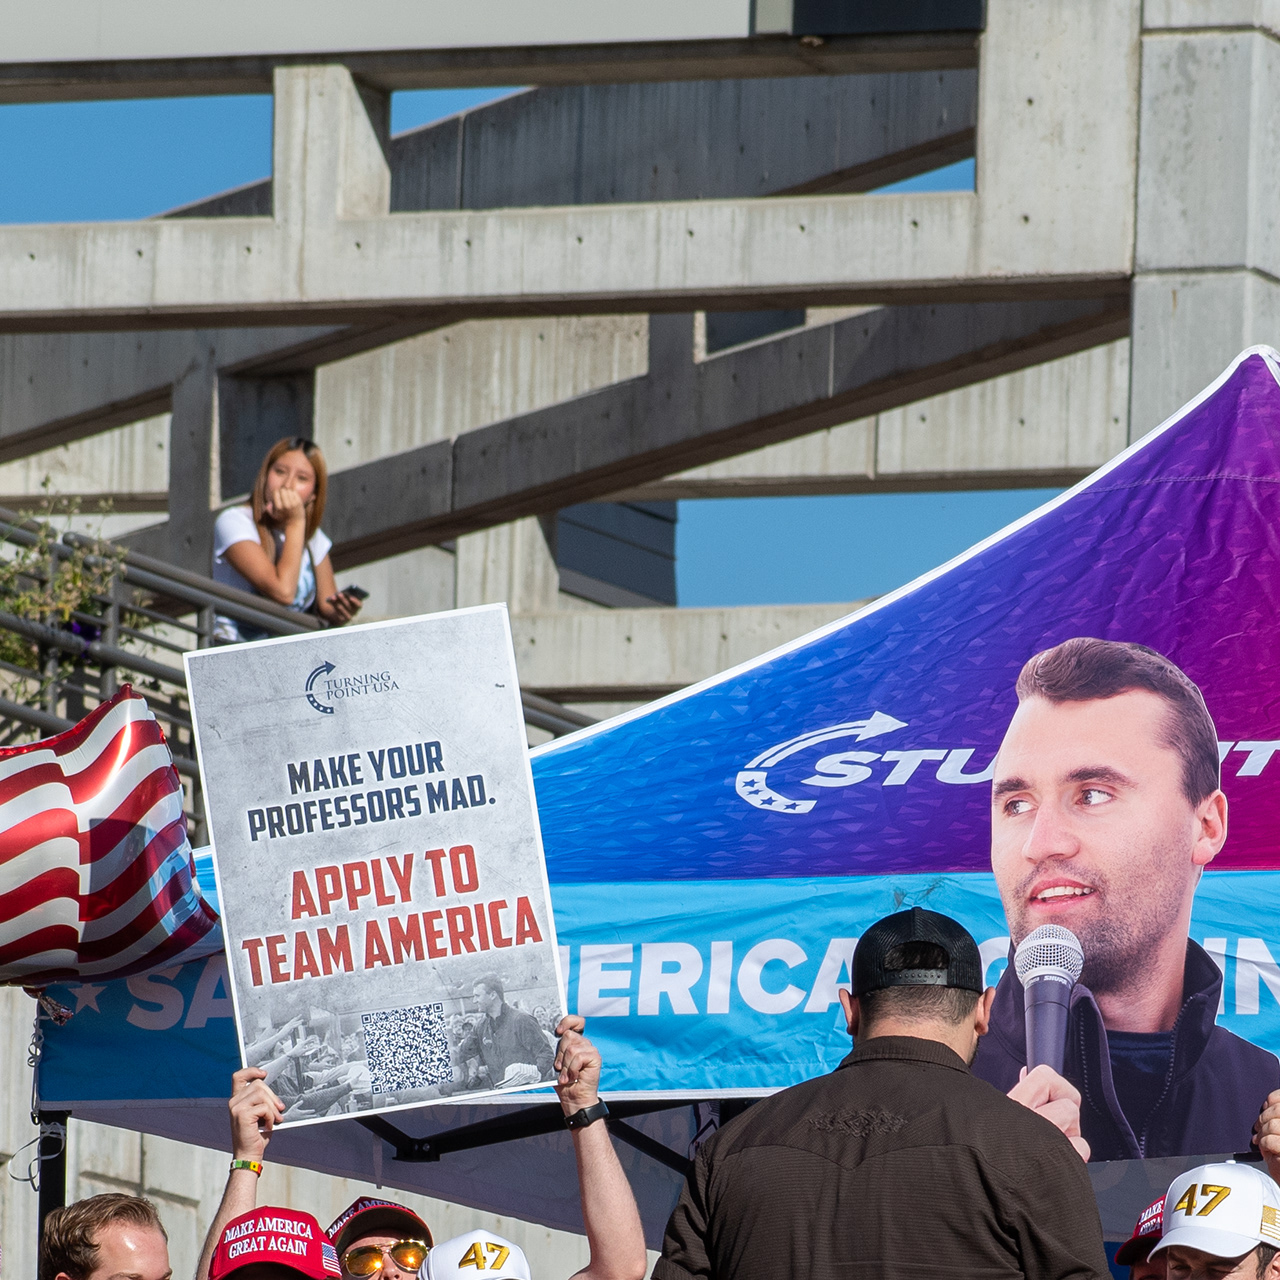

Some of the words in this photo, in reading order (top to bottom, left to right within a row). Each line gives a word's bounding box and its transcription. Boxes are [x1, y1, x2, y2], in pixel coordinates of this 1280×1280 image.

[324, 671, 391, 691] TURNING
[326, 684, 369, 700] POINT
[371, 681, 400, 694] USA
[288, 752, 363, 795] MAKE
[368, 741, 445, 781] YOUR
[248, 785, 422, 842] PROFESSORS
[427, 775, 496, 814] MAD.
[290, 852, 414, 921] APPLY
[424, 844, 480, 897] TO
[242, 924, 355, 987] TEAM
[364, 896, 543, 970] AMERICA
[125, 965, 233, 1031] SA
[558, 938, 859, 1018] ERICA
[1174, 1183, 1232, 1217] 47
[225, 1221, 255, 1243] MAKE
[256, 1218, 312, 1239] AMERICA
[328, 1208, 355, 1238] MAKE
[1139, 1217, 1163, 1235] GREA
[229, 1238, 269, 1259] GREAT
[270, 1235, 307, 1256] AGAIN
[458, 1242, 511, 1270] 47
